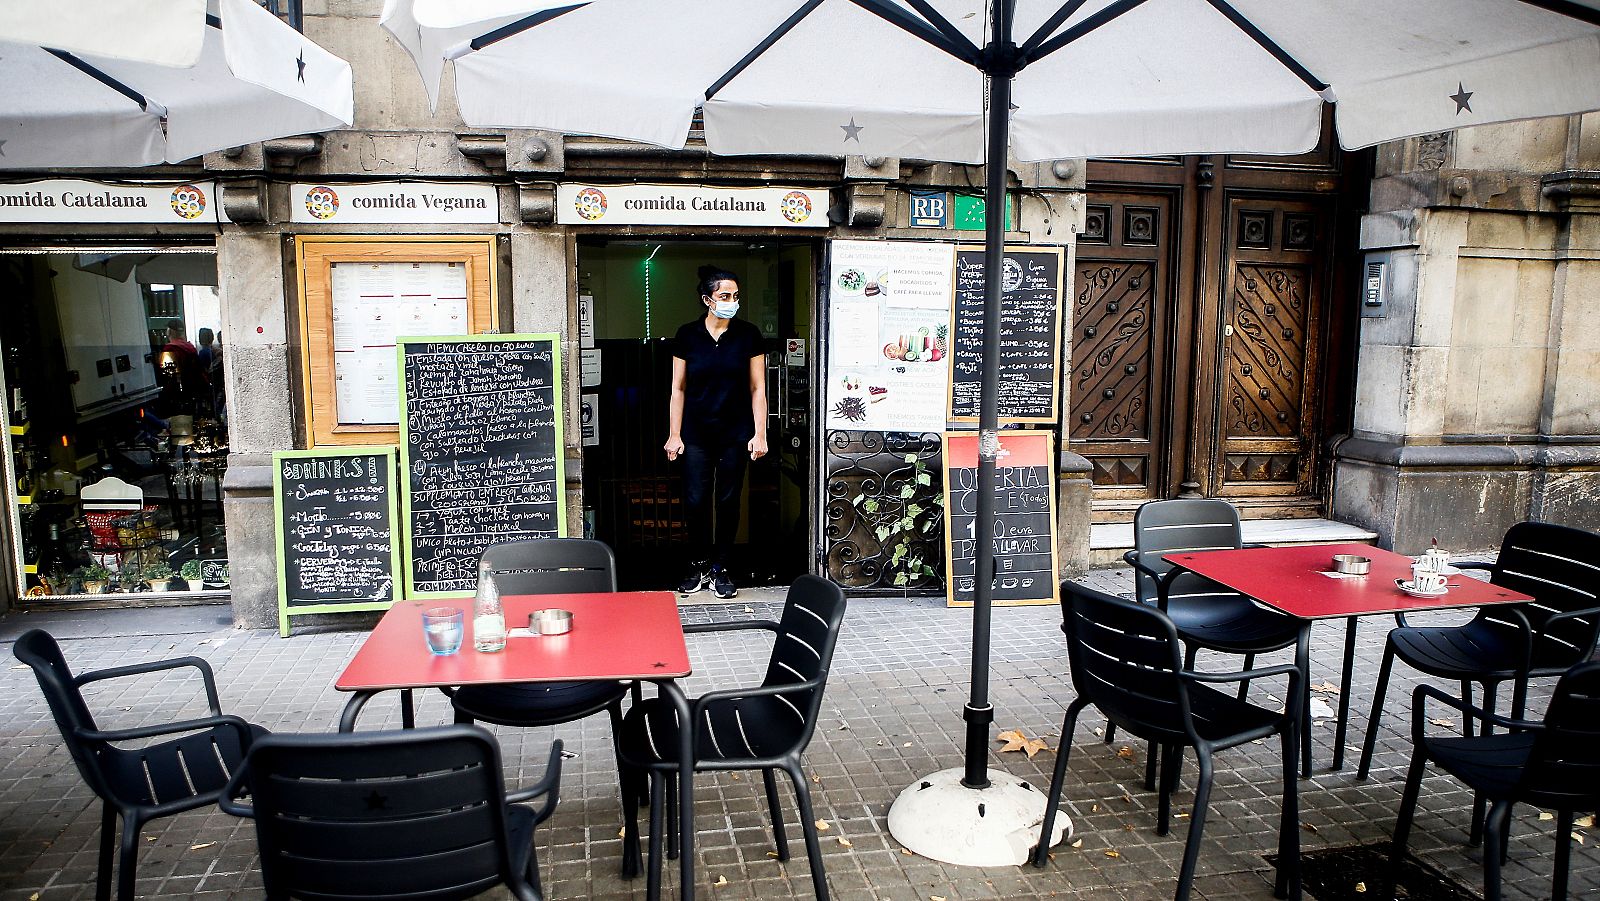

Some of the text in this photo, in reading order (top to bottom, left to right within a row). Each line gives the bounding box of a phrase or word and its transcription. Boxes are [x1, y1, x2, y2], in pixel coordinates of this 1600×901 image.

[61, 192, 148, 208] Catalana
[352, 193, 488, 212] comida Vegana
[624, 196, 767, 212] comida Catalana
[427, 343, 454, 354] MENU
[420, 442, 434, 452] con
[1010, 526, 1033, 536] euro
